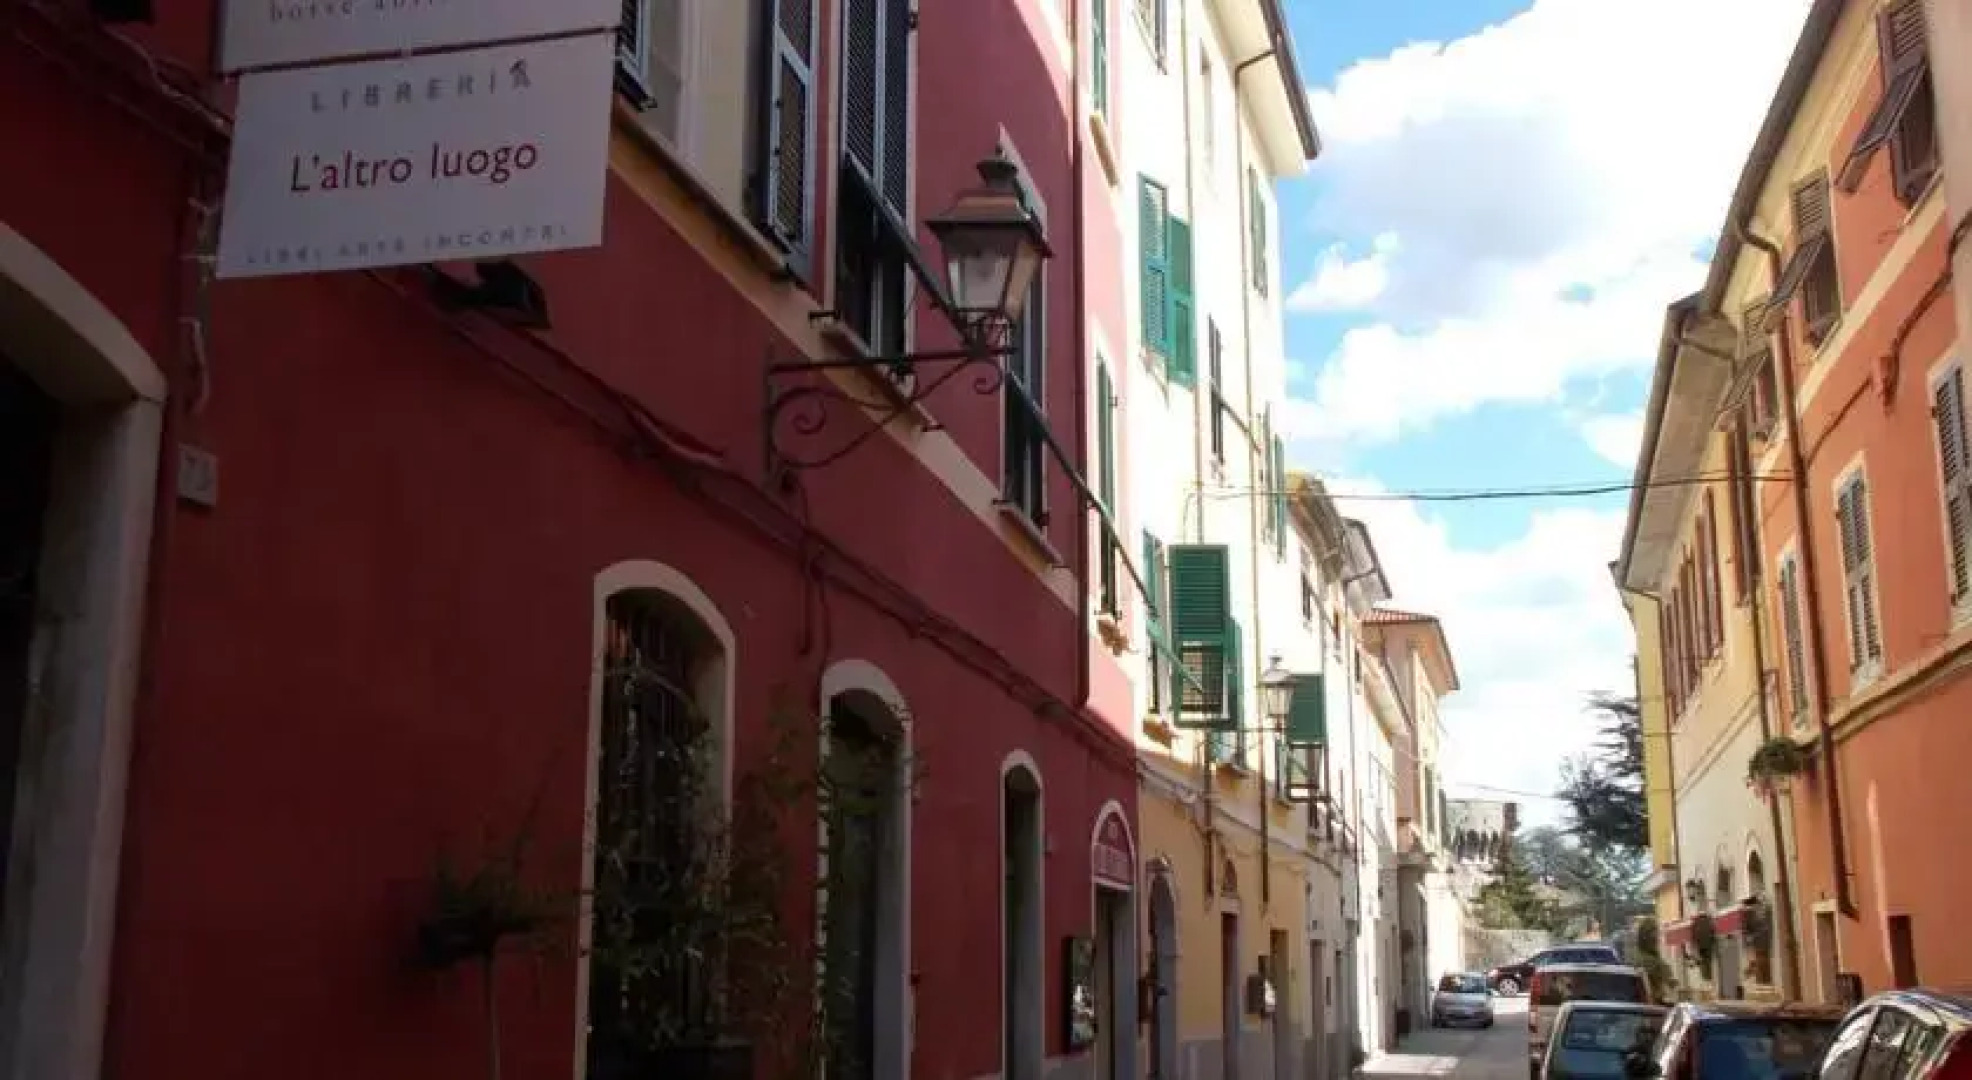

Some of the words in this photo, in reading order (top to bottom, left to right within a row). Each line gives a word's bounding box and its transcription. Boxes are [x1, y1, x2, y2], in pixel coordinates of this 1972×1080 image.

[311, 60, 531, 112] LIBRERIA
[290, 149, 412, 193] L'altro
[431, 142, 538, 184] luogo
